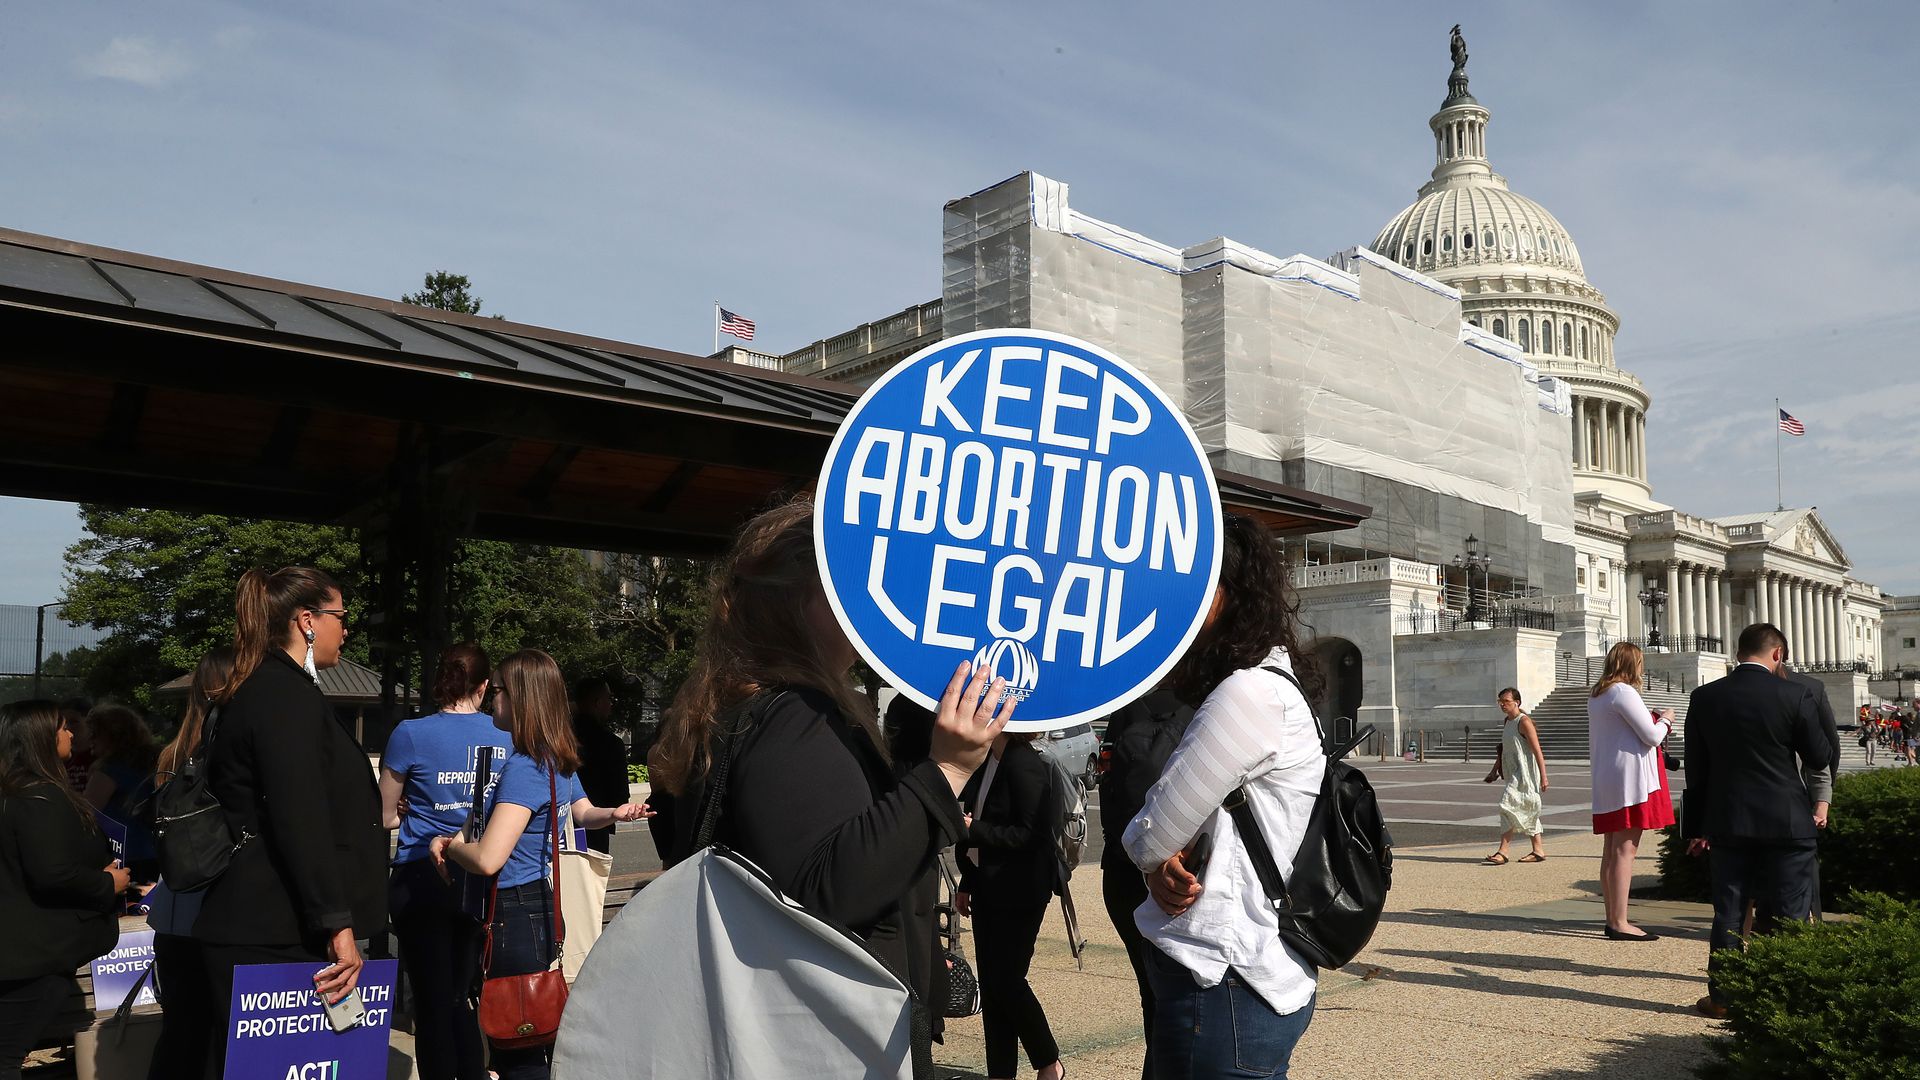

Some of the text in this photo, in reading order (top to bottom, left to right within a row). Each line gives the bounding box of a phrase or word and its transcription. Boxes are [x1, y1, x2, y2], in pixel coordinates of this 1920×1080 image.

[921, 345, 1152, 455] KEEP
[843, 426, 1199, 575] ABORTION
[867, 535, 1158, 668] LEGAL
[971, 639, 1039, 691] NOW
[474, 745, 506, 760] CTER
[284, 1060, 339, 1080] ACT!
